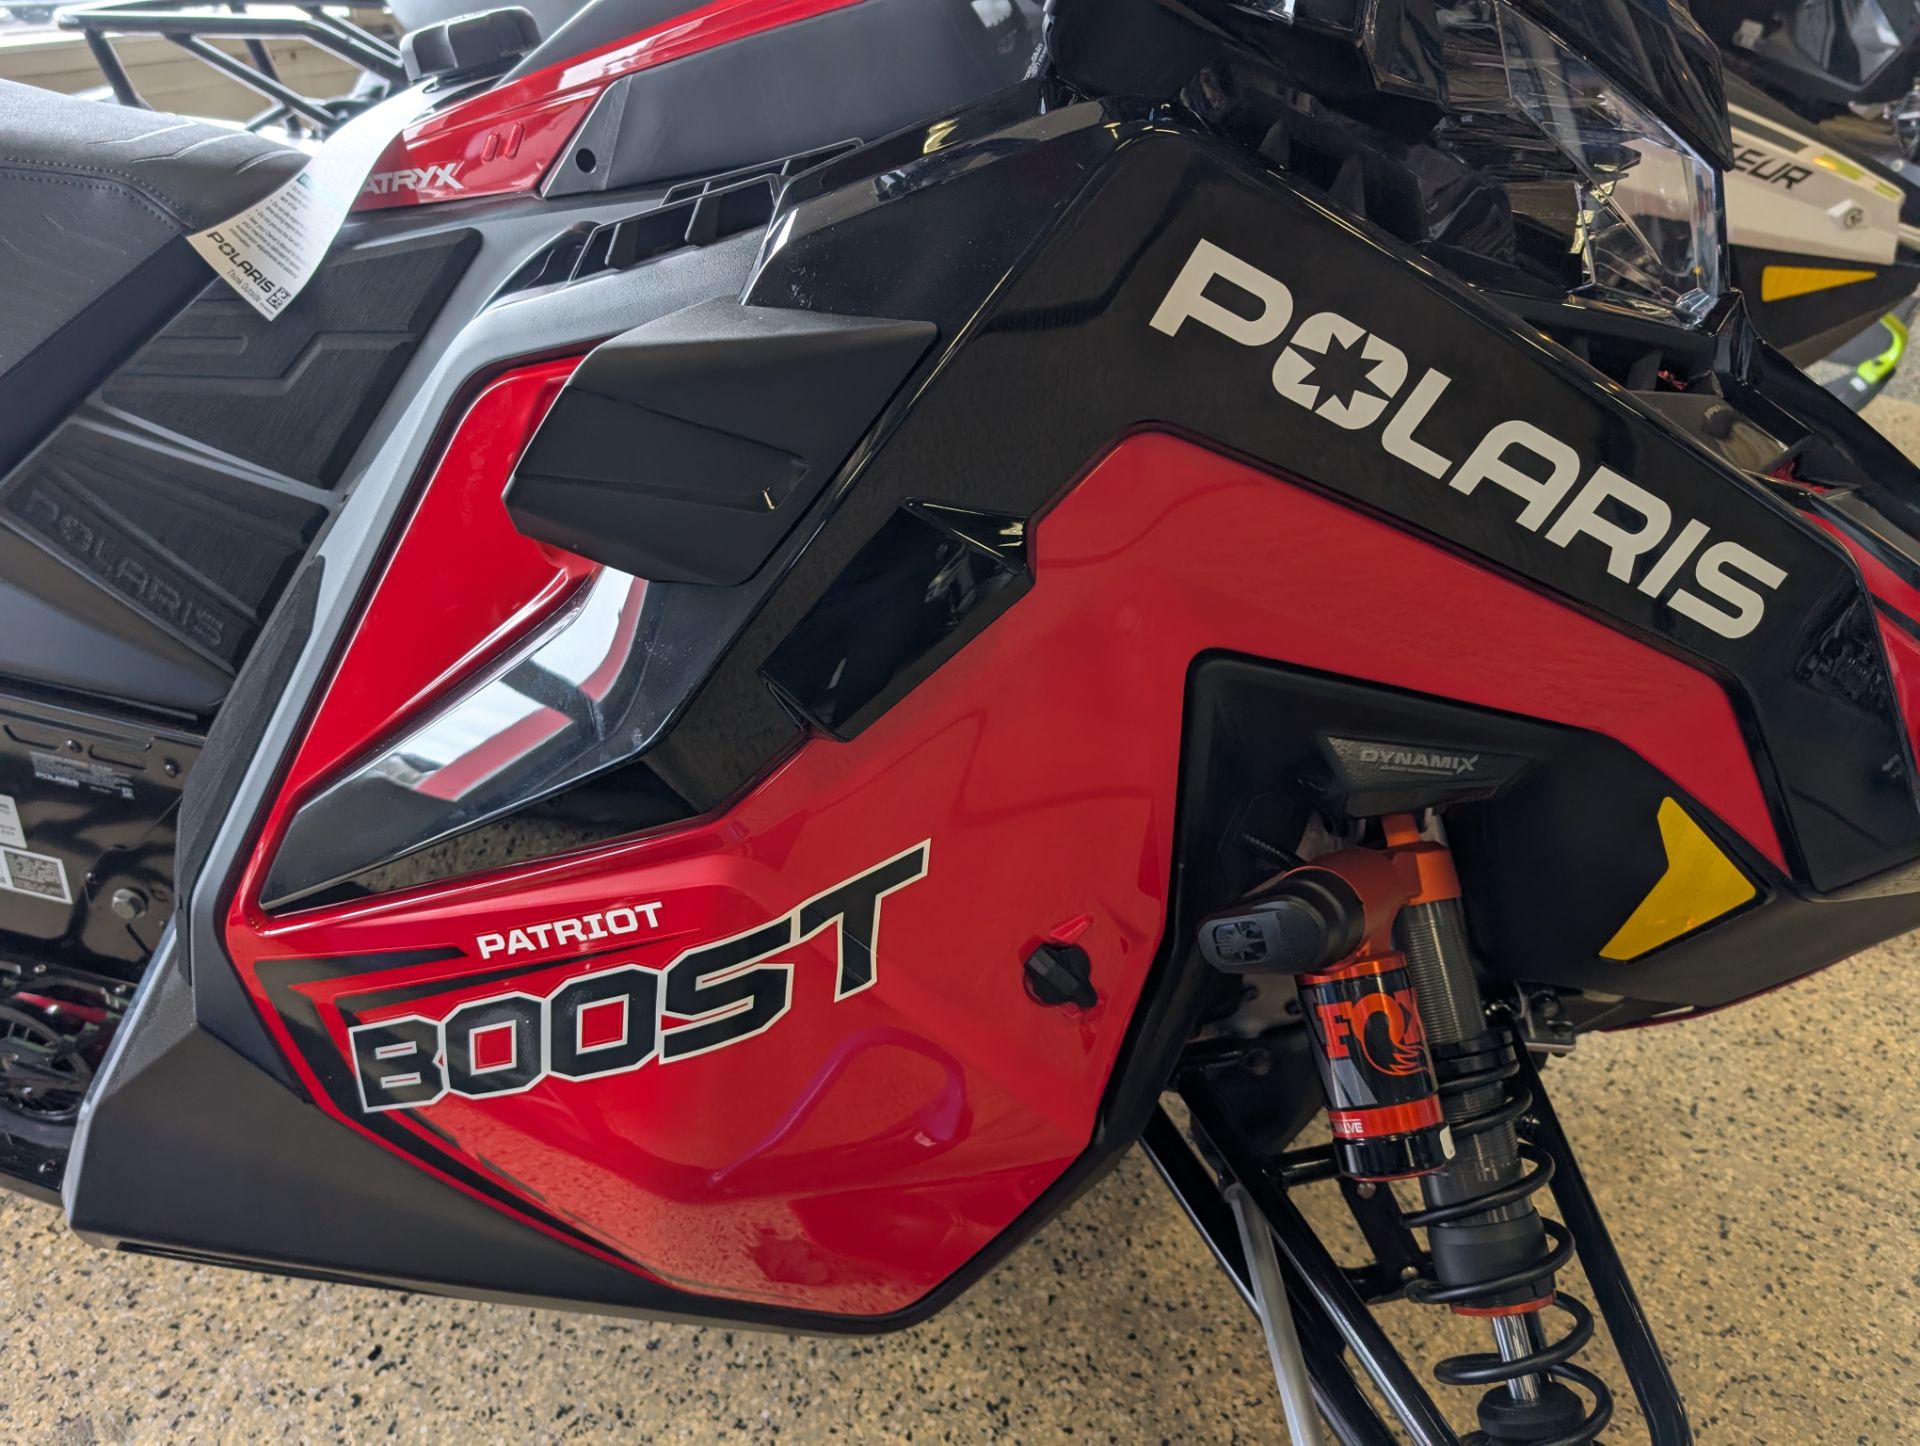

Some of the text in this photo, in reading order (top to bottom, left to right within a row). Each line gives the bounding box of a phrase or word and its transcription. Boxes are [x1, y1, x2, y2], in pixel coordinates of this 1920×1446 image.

[1731, 143, 1814, 190] EUR
[206, 231, 276, 294] POLARIS
[1149, 238, 1788, 639] POLARIS
[1360, 749, 1480, 775] DYNAMIX
[476, 901, 663, 960] PATRIOT
[348, 838, 931, 1113] BOOST
[1315, 987, 1427, 1076] FOX
